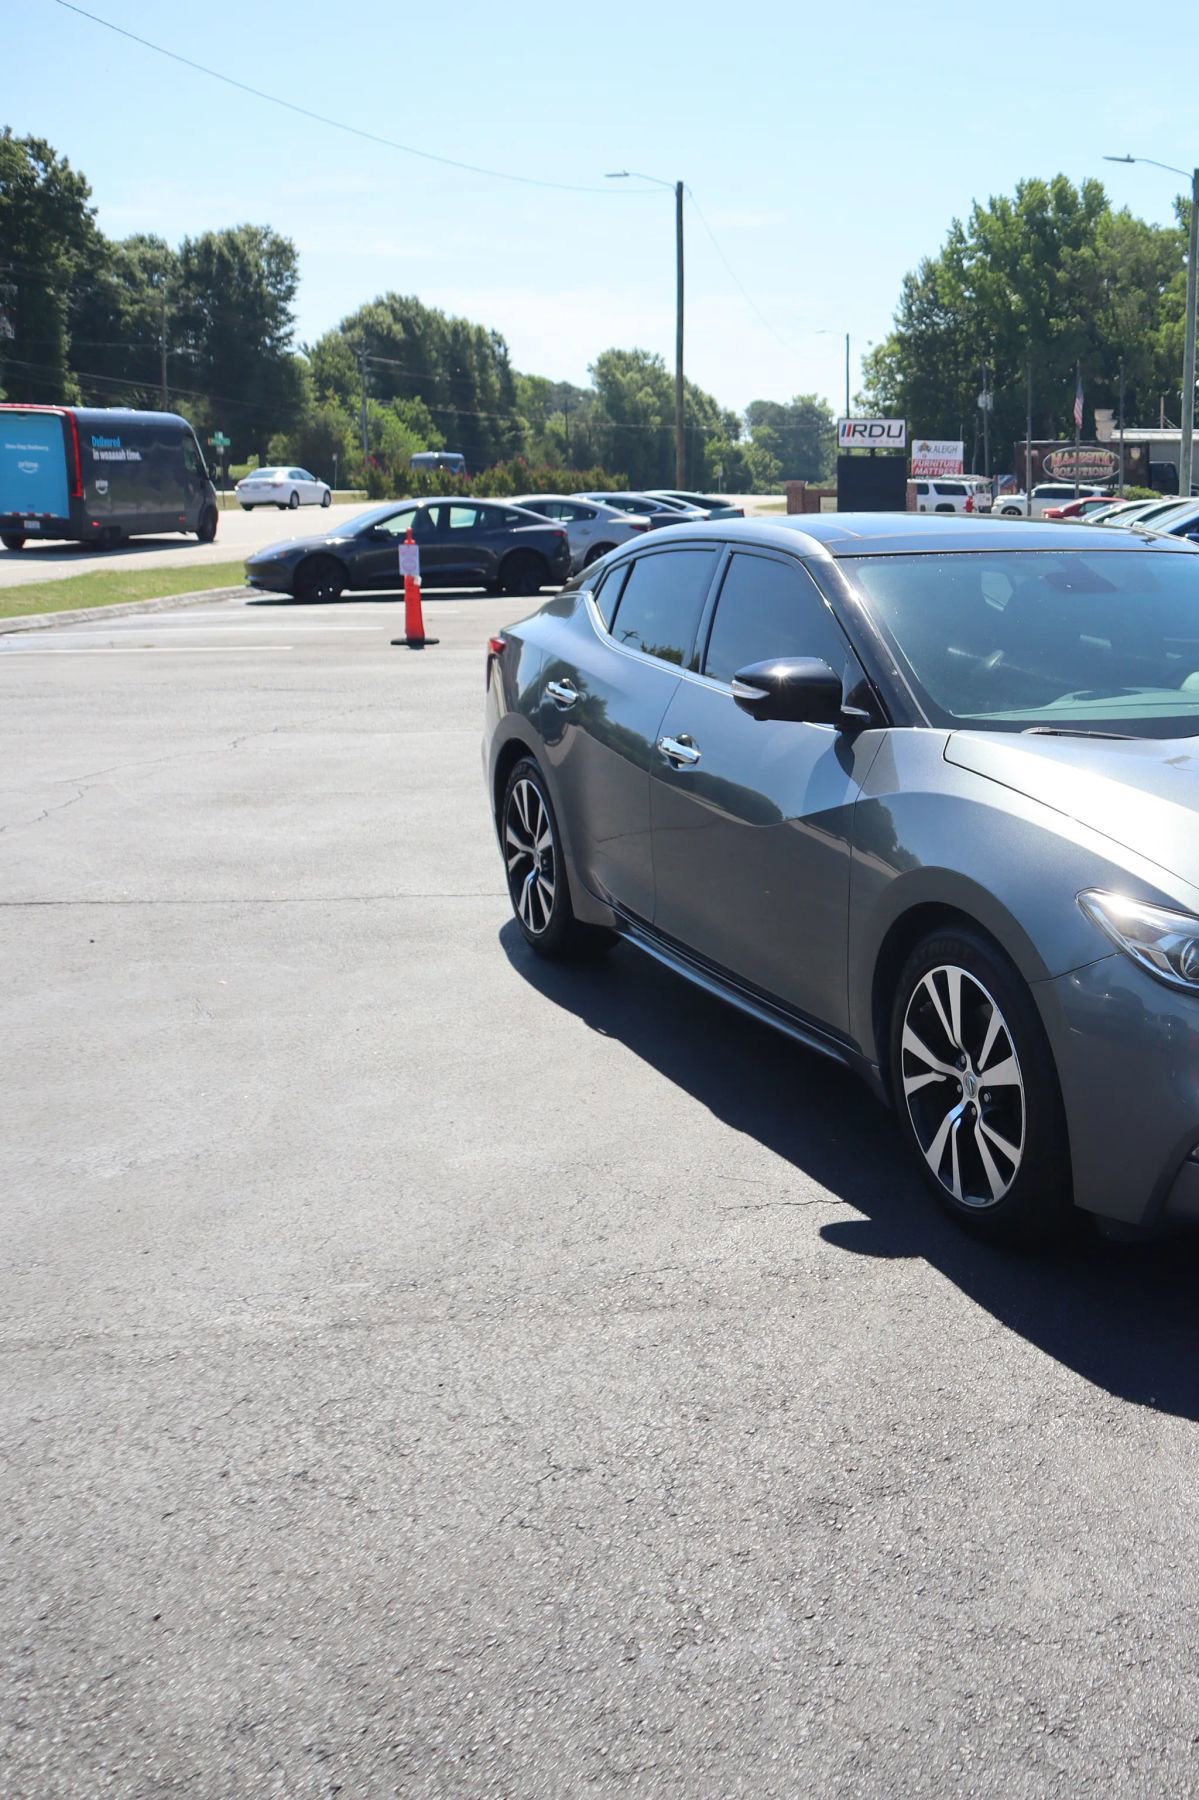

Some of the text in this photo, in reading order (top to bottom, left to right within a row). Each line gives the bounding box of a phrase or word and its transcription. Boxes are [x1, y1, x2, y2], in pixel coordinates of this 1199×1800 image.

[851, 423, 904, 438] RDU
[913, 460, 960, 468] FURNITURE
[914, 467, 960, 475] MATTRESS
